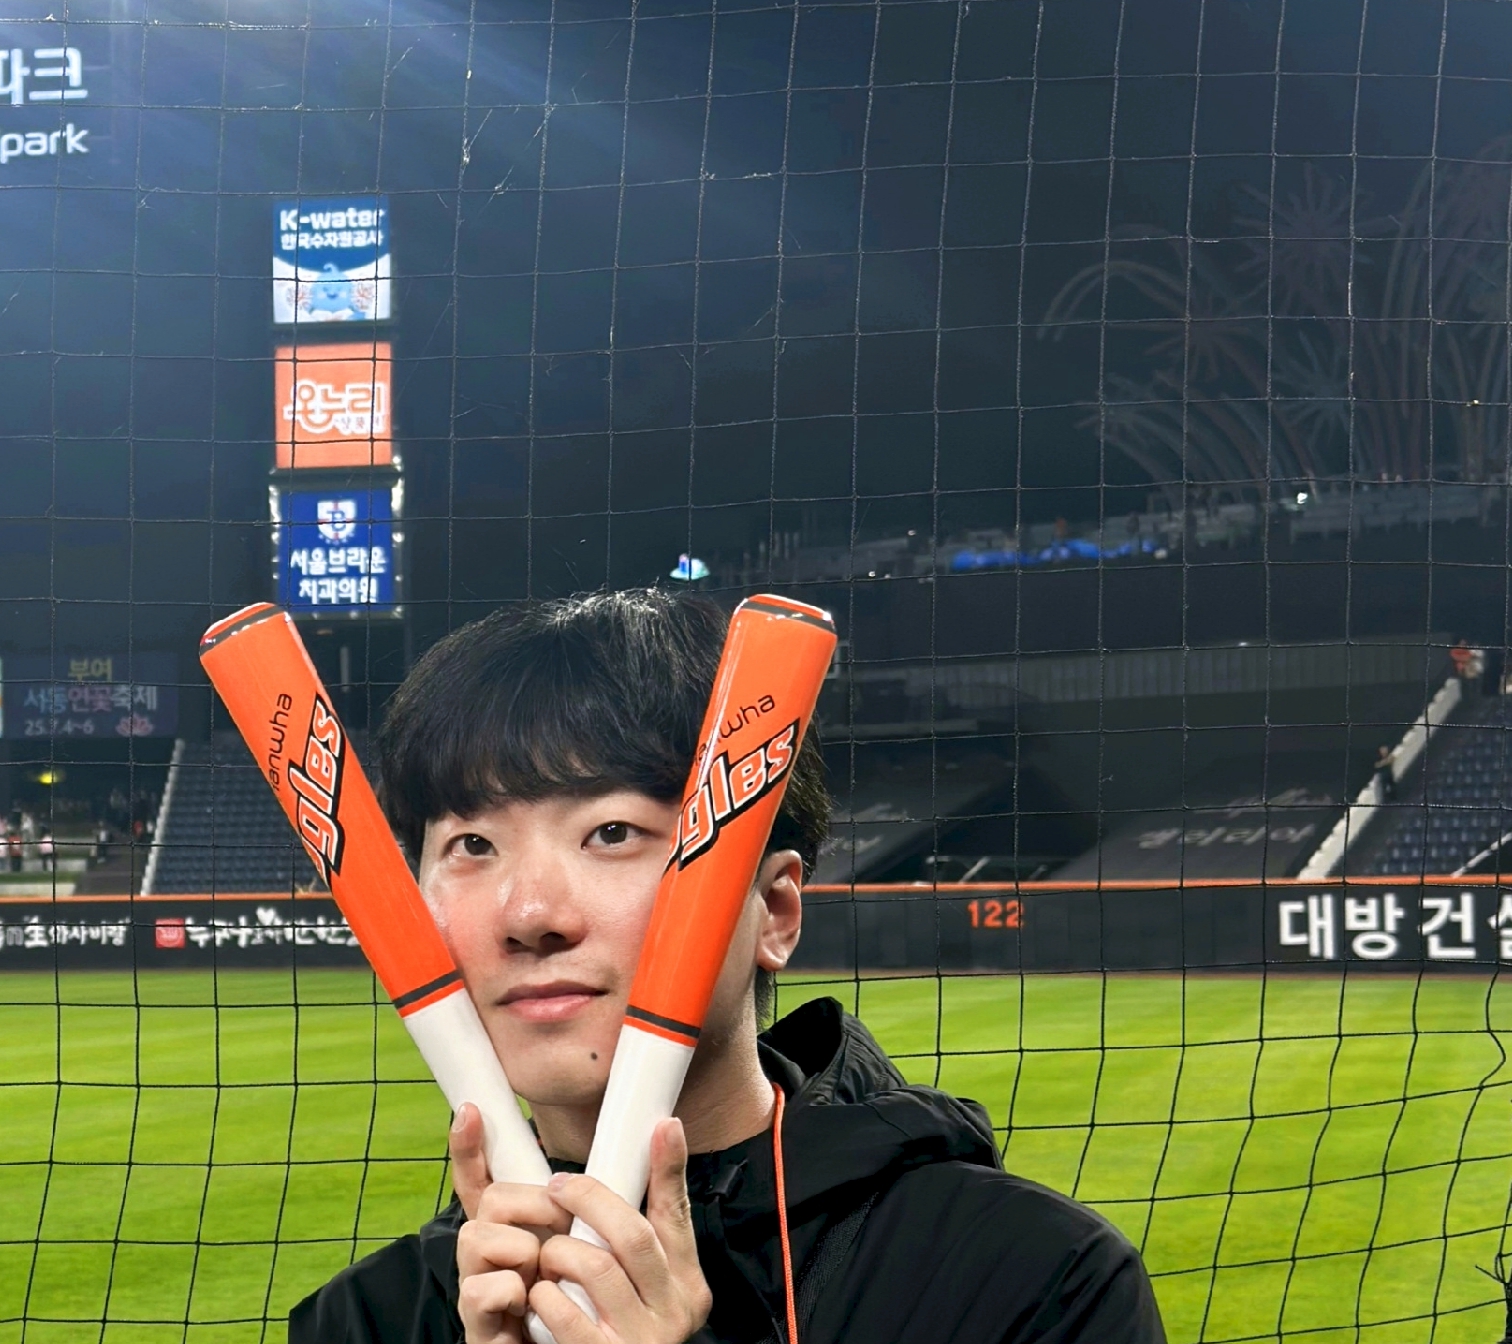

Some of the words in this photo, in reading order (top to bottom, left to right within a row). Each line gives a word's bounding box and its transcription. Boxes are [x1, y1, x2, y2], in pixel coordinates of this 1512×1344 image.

[280, 207, 386, 231] K-water
[280, 229, 384, 251] 한국수자원공사
[290, 546, 387, 575] 서울브라운
[298, 576, 378, 605] 치과의원
[68, 658, 113, 683] 부여
[967, 899, 1024, 929] 122
